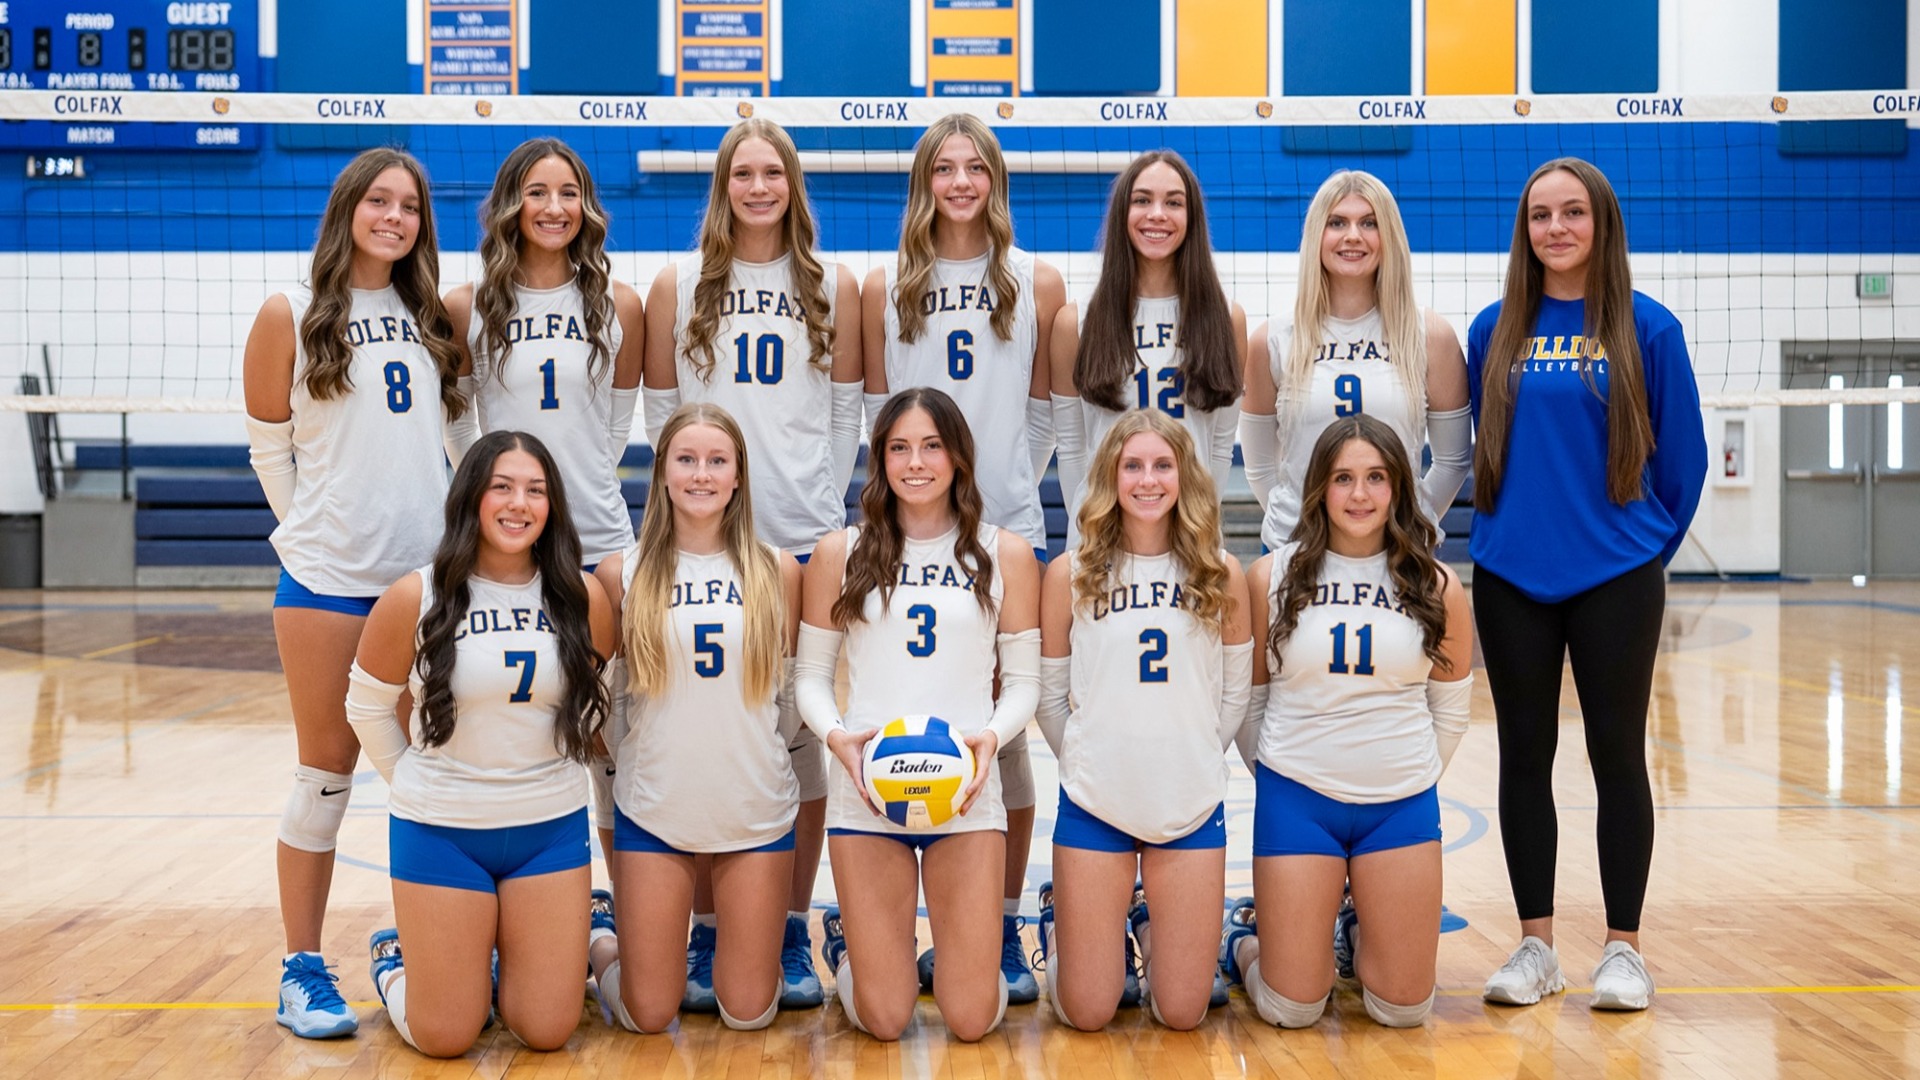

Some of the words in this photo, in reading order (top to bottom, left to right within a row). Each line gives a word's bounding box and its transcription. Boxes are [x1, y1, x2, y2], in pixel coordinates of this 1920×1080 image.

[65, 13, 114, 30] PERIOD
[167, 2, 232, 25] GUEST
[47, 72, 98, 89] PLAYER
[100, 72, 135, 89] FOUL
[195, 73, 240, 90] FOULS
[54, 95, 123, 115] COLFAX
[317, 98, 386, 118] COLFAX
[579, 101, 648, 120] COLFAX
[841, 102, 908, 121] COLFAX
[1100, 102, 1168, 121] COLFAX
[1359, 100, 1426, 119] COLFAX
[1616, 98, 1684, 117] COLFAX
[67, 127, 115, 144] MATCH
[195, 127, 240, 145] SCORE
[920, 285, 996, 316] OLFA
[347, 316, 421, 346] OLFA
[506, 313, 594, 344] OLFA
[734, 332, 784, 385] 10
[947, 329, 974, 381] 6
[1511, 361, 1605, 374] OLLEYBAL
[383, 361, 413, 414] 8
[539, 358, 560, 411] 1
[1134, 366, 1185, 419] 12
[1334, 374, 1363, 419] 9
[906, 604, 937, 658] 3
[693, 623, 725, 679] 5
[1139, 628, 1169, 683] 2
[1328, 622, 1375, 677] 11
[503, 650, 537, 703] 7
[890, 759, 943, 774] Baden
[904, 786, 931, 795] LEXUM
